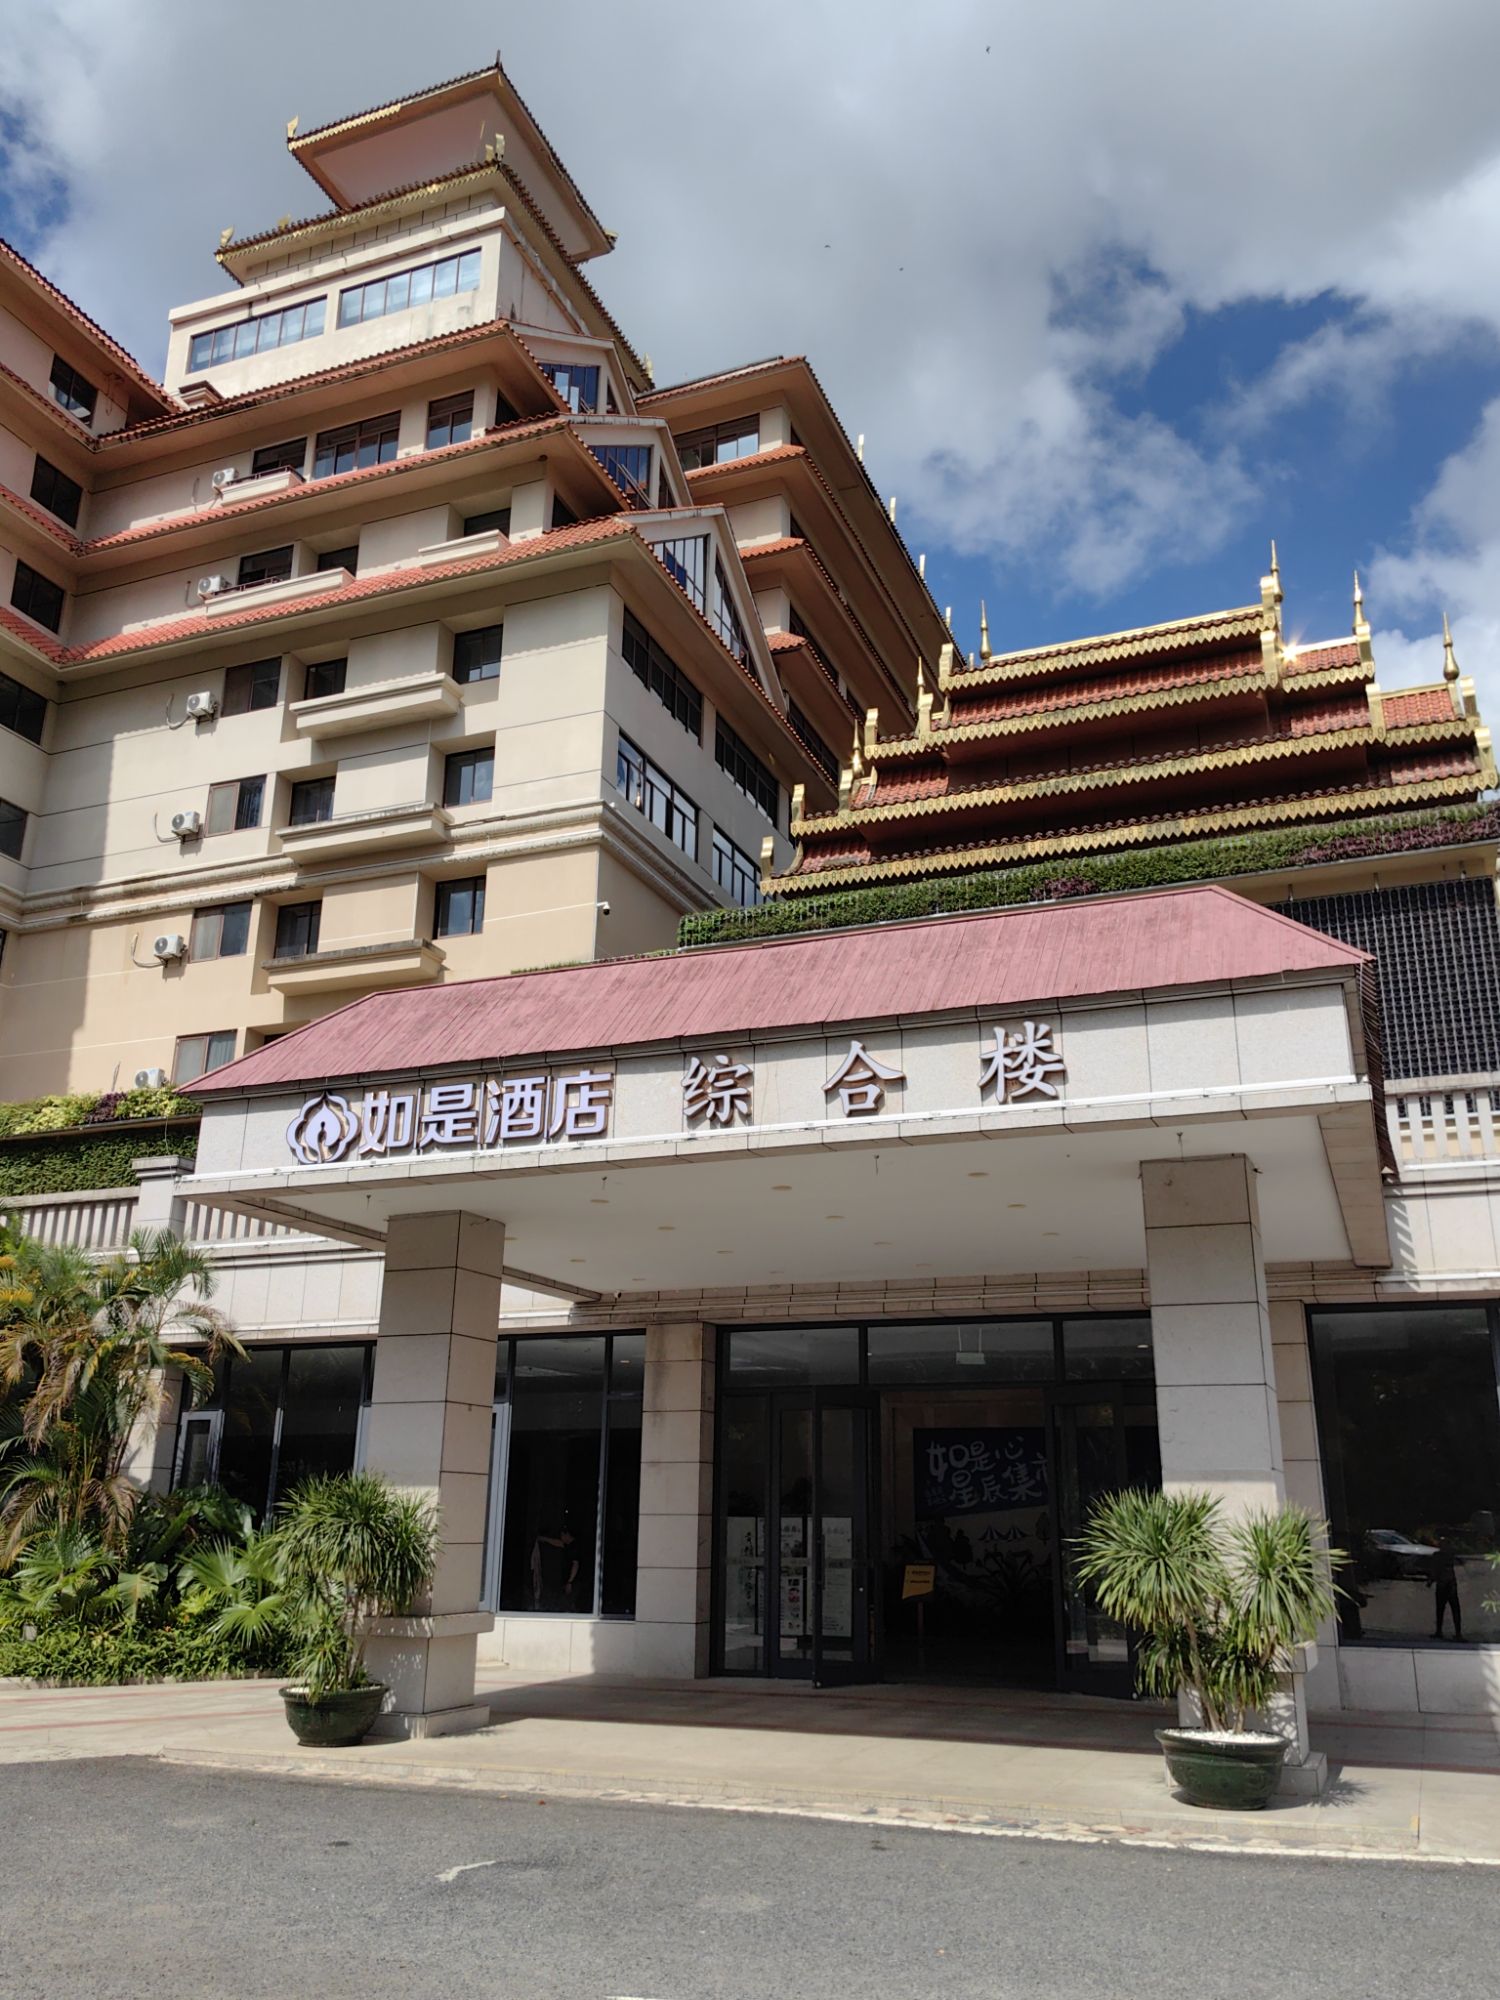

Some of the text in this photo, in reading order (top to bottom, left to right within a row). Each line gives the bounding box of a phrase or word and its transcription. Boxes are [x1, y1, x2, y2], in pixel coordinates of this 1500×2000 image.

[360, 1070, 612, 1154] 如是酒店
[681, 1021, 1066, 1123] 综合楼
